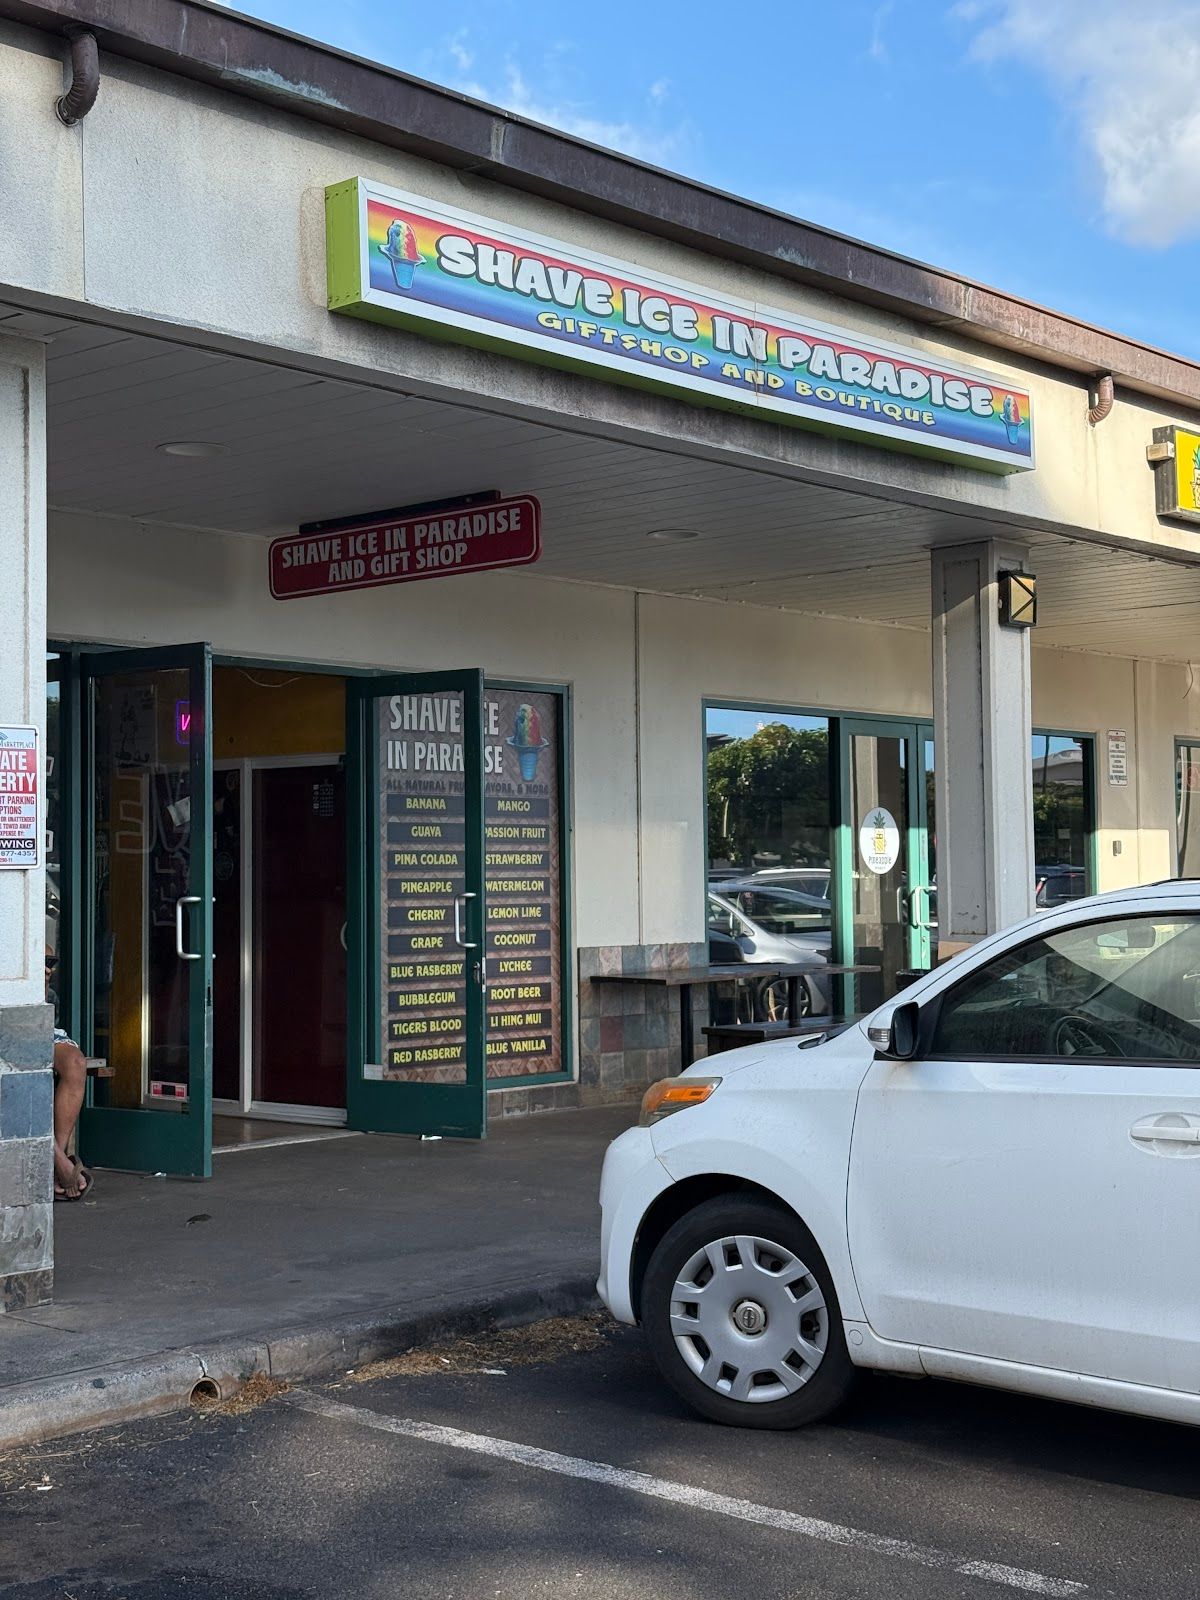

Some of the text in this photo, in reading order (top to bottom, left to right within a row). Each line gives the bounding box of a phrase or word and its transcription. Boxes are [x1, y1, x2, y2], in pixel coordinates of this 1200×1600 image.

[437, 234, 994, 418] SHAVE ICE IN PARADISE
[536, 312, 936, 427] GIFTSHOP AND BOUTIQUE
[282, 508, 521, 569] SHAVE ICE IN PARADISE
[328, 542, 468, 583] AND GIFT SHOP
[389, 695, 461, 733] SHAVE
[0, 751, 27, 770] ATE
[387, 740, 503, 774] IN PARASE
[386, 780, 402, 791] ALL
[405, 780, 446, 792] NATURAL
[8, 796, 34, 805] PARKING
[406, 798, 446, 810] BANANA
[497, 800, 530, 812] MANGO
[411, 826, 441, 837] GUAVA
[485, 827, 546, 839] ASSION FRUIT
[0, 840, 33, 848] WING
[395, 854, 458, 865] PINA COLADA
[486, 854, 543, 865] STRAWBERRY
[401, 881, 453, 893] PINEAPPLE
[486, 880, 544, 892] WATERMELON
[408, 909, 445, 921] CHERRY
[488, 906, 542, 918] LEMON LIME
[411, 937, 443, 949] GRAPE
[494, 933, 537, 945] COCONUT
[391, 963, 463, 978] BLUE RASBERRY
[499, 960, 532, 973] LYCHEE
[399, 991, 456, 1006] BUBBLEGUM
[491, 986, 541, 1000] ROOT BEER
[491, 1013, 542, 1027] LI HING MUI
[393, 1018, 461, 1035] TIGERS BLOOD
[486, 1039, 546, 1055] BLUE VANILLA
[394, 1047, 462, 1063] RED RASBERRY
